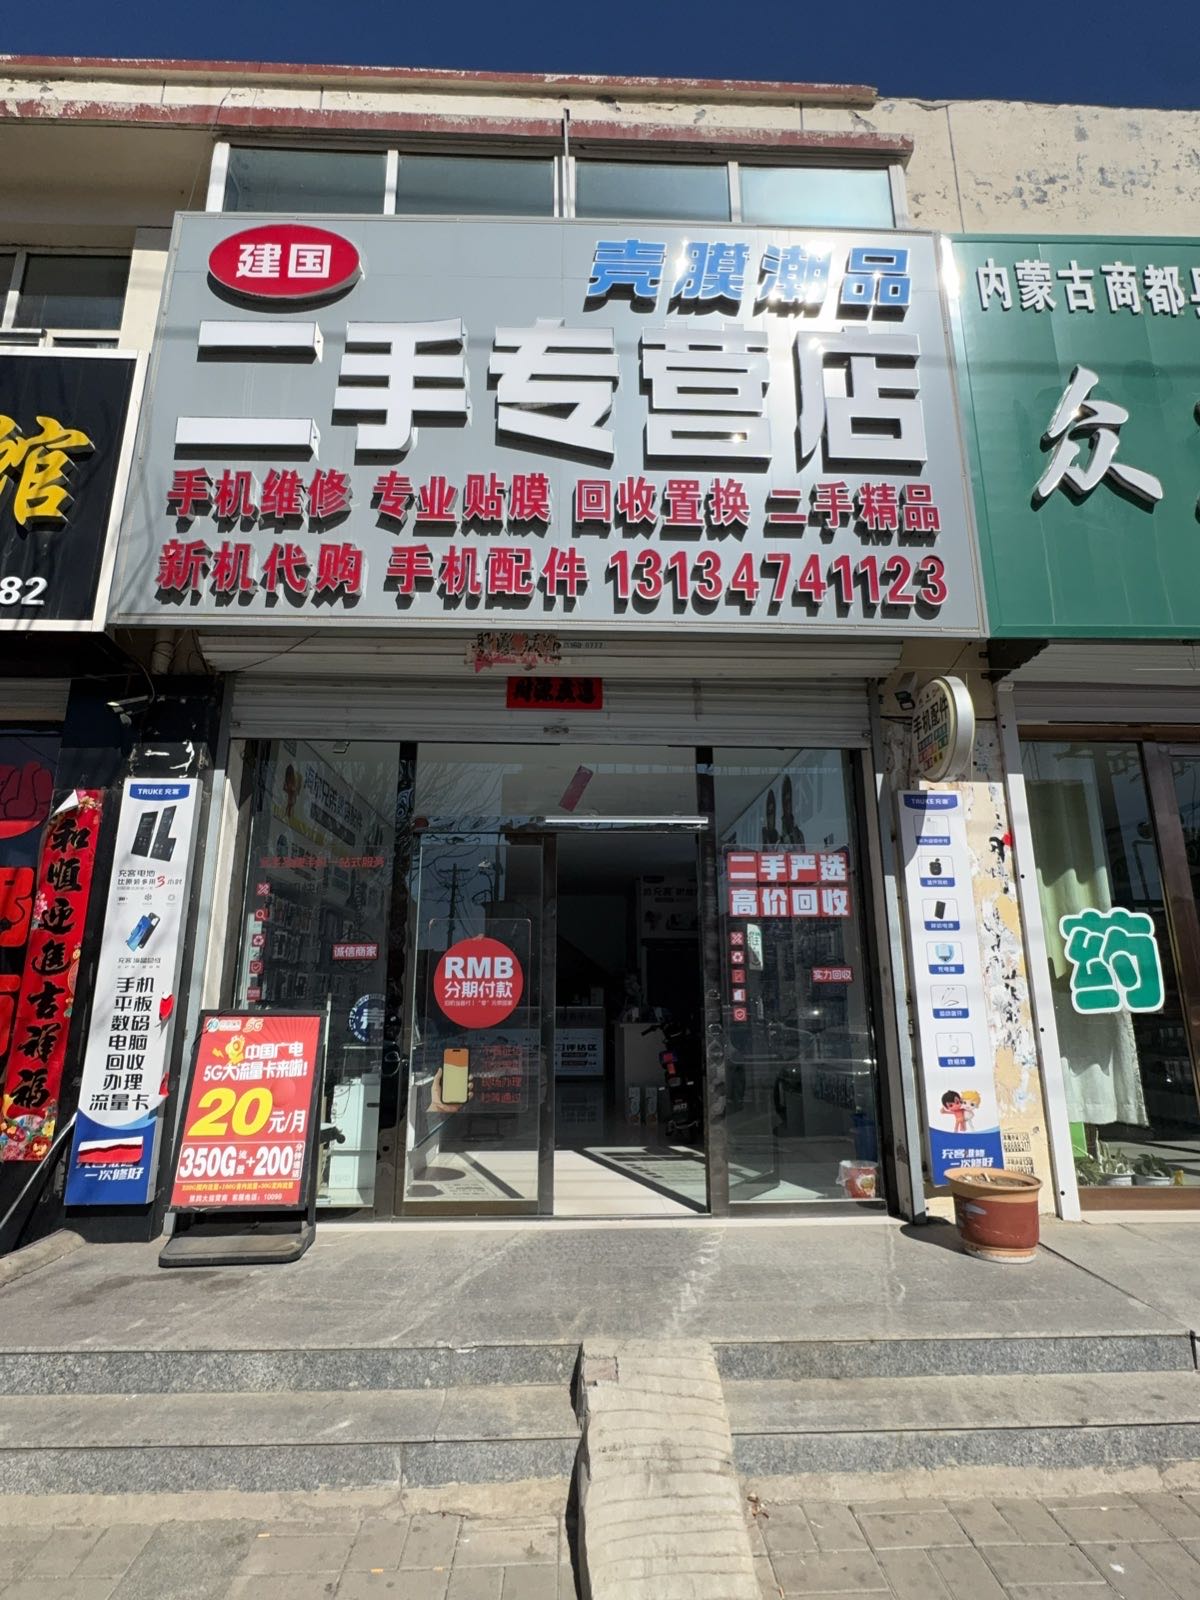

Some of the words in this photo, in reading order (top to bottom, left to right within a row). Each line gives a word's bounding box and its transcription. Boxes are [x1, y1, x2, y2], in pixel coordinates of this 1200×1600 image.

[237, 243, 332, 279] 建国
[587, 239, 911, 307] 壳膜潮品
[175, 317, 927, 462] 二手专营店
[167, 468, 351, 520] 手机维修
[373, 471, 550, 522] 专业贴膜
[575, 477, 749, 528] 回收置换
[770, 482, 940, 532] 二手精品
[156, 538, 363, 595] 新机代购
[387, 544, 588, 597] 手机配件
[609, 550, 948, 605] 13134741123
[0, 576, 48, 605] 82
[913, 694, 949, 740] 手机配件
[731, 854, 847, 881] 二手严选
[731, 888, 848, 916] 高价回收
[333, 945, 378, 958] 诚信商家
[1059, 907, 1165, 1014] 药
[444, 956, 514, 979] RMB
[813, 969, 852, 981] 实力回收
[117, 976, 155, 993] 手机
[444, 980, 513, 999] 分期付款
[114, 996, 152, 1012] 平板
[110, 1015, 150, 1031] 数码
[108, 1034, 148, 1051] 电脑
[245, 1041, 304, 1060] 中国广电
[105, 1054, 145, 1071] 回收
[102, 1074, 143, 1090] 办理
[89, 1094, 150, 1111] 流量卡
[84, 1167, 145, 1181] 一次修好
